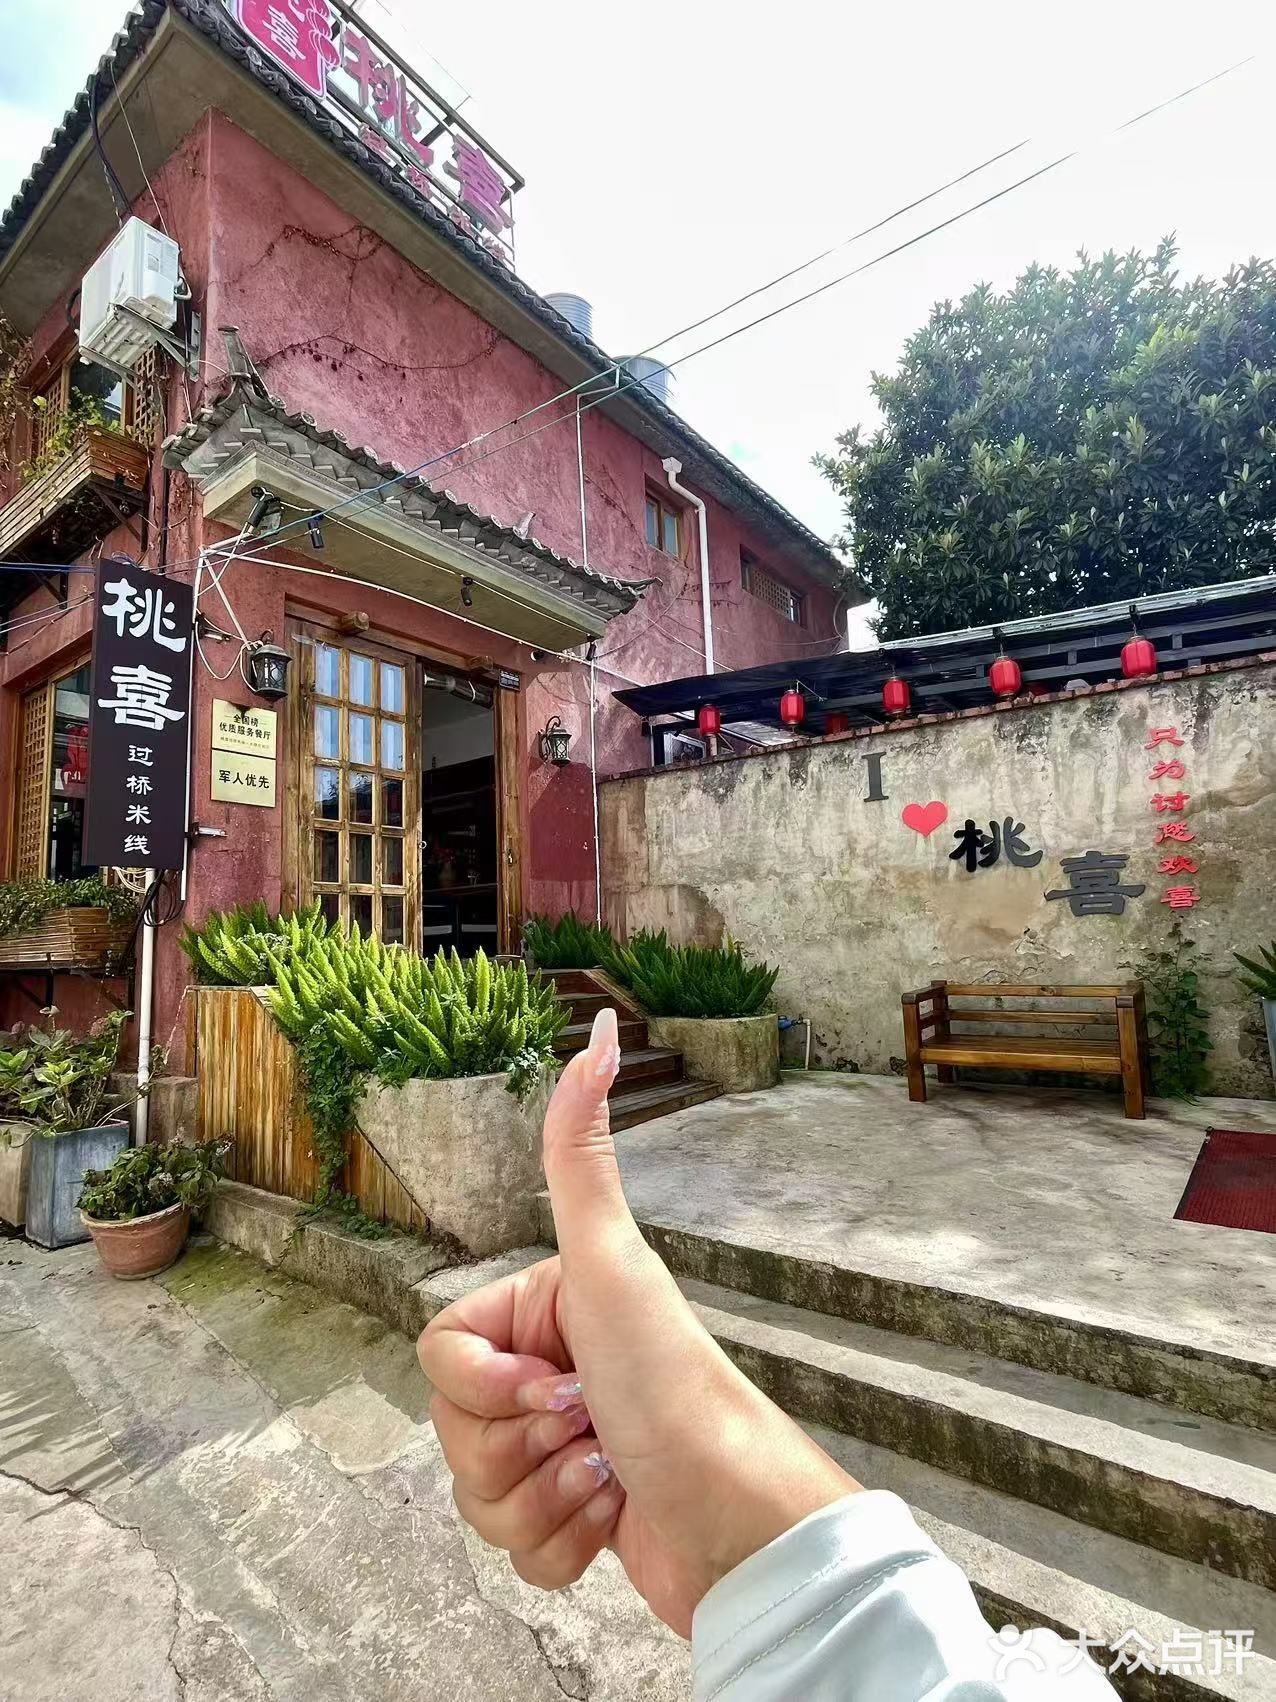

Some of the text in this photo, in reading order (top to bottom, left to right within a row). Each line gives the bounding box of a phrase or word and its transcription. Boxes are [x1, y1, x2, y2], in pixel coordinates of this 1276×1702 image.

[98, 578, 186, 731] 桃喜
[218, 769, 270, 789] 军人优先
[219, 722, 271, 740] 优质服务餐厅
[123, 744, 153, 855] 过桥米线
[861, 751, 1145, 917] I 桃喜
